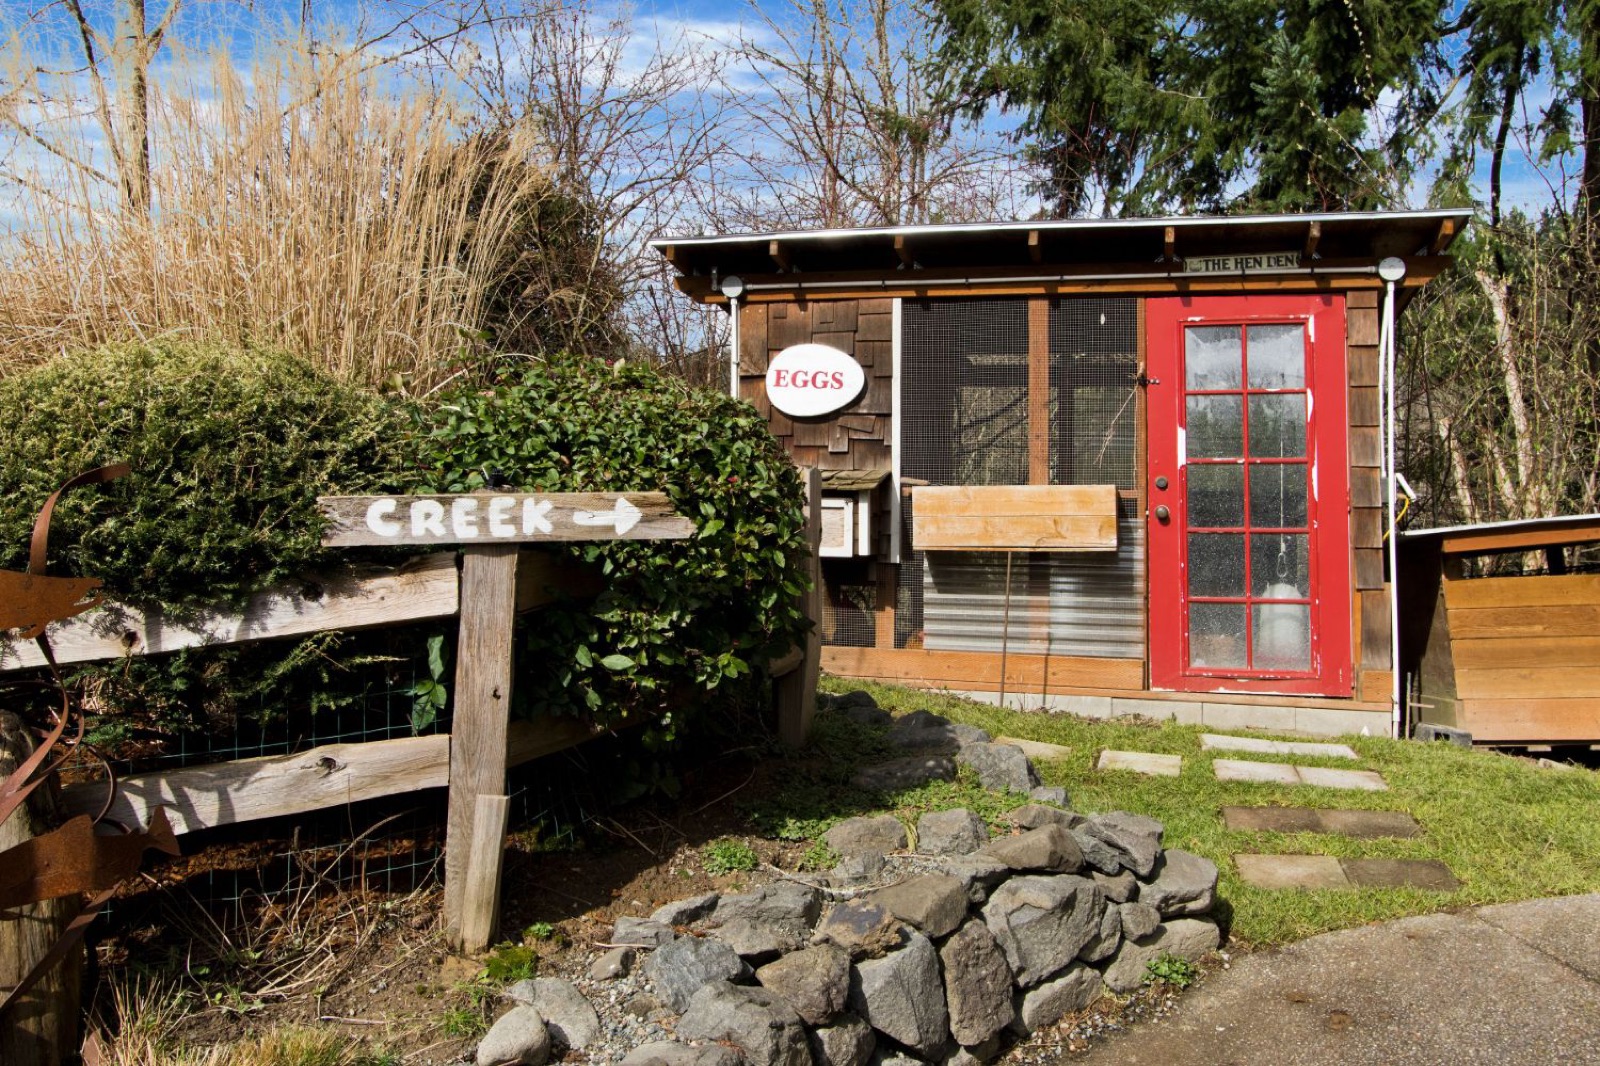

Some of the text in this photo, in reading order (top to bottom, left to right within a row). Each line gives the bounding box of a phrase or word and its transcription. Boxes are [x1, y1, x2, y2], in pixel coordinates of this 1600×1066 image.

[1202, 258, 1231, 272] THE
[1234, 256, 1262, 270] HEN
[773, 369, 844, 389] EGGS
[366, 497, 553, 538] CREEK
